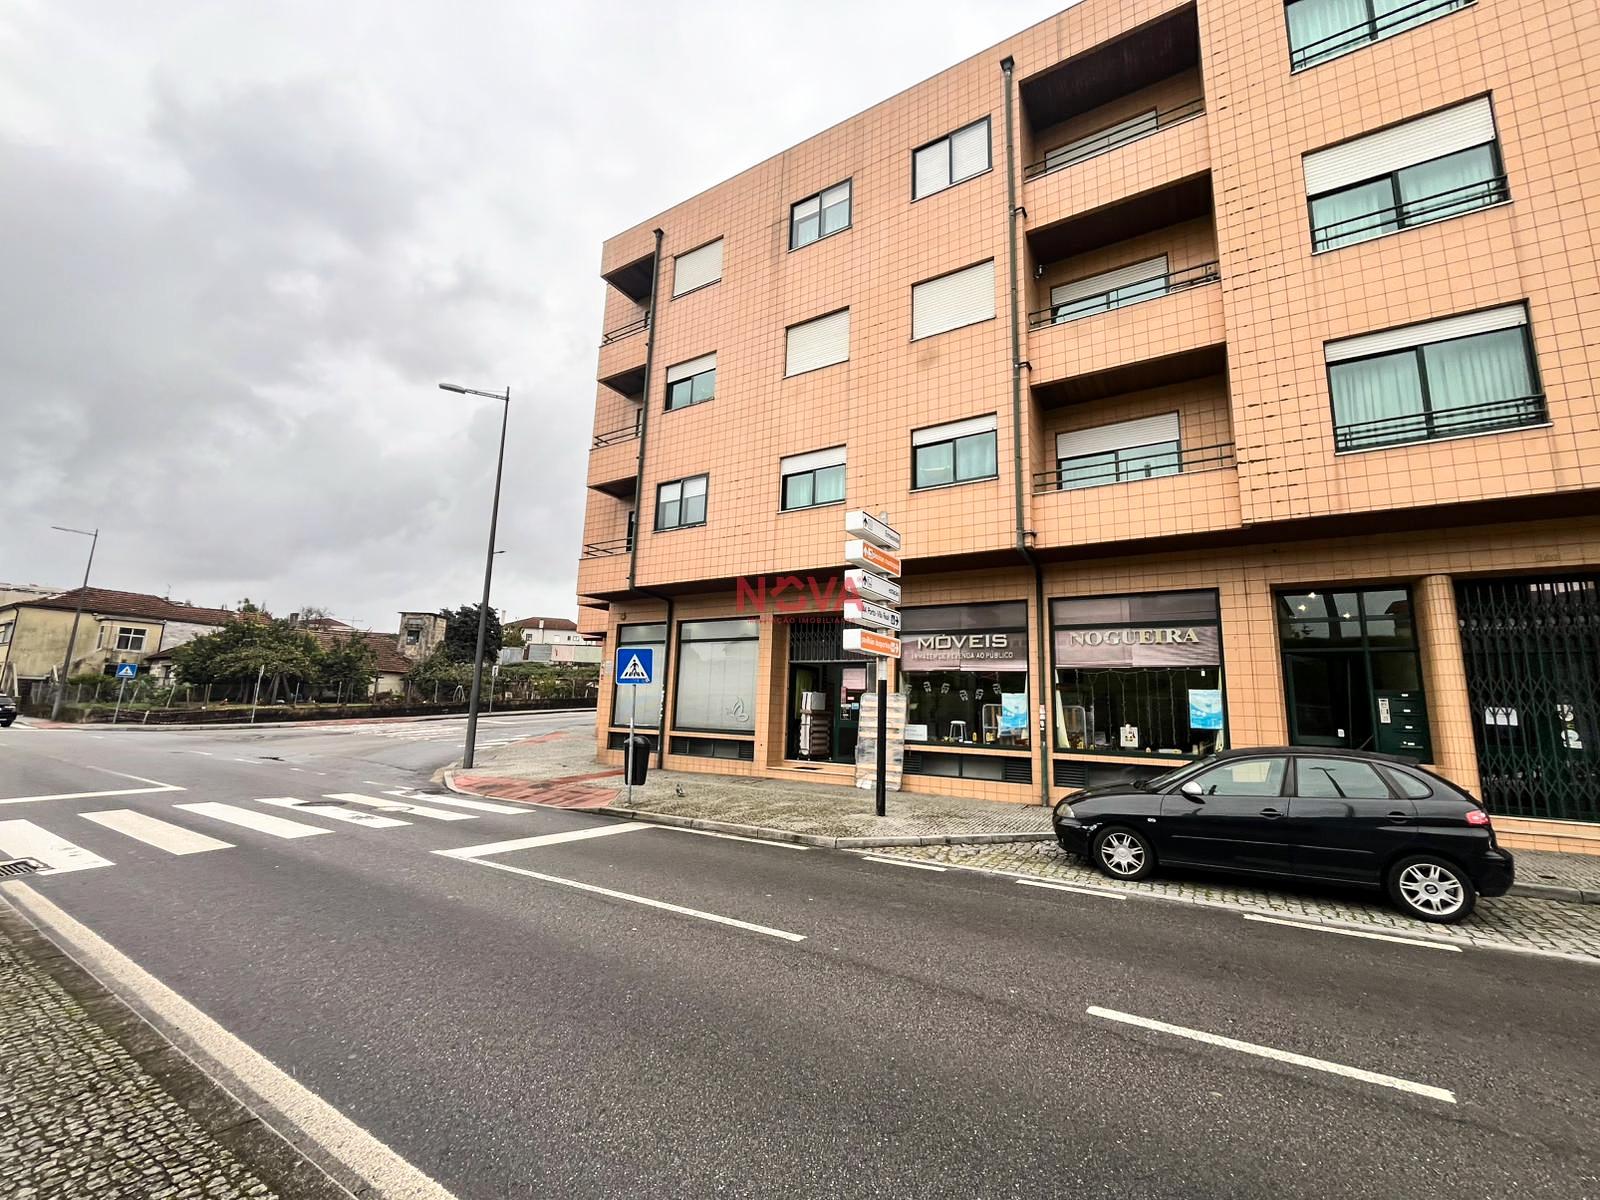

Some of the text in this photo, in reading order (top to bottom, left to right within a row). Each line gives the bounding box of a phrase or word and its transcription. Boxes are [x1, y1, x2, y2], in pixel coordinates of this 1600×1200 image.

[917, 634, 1008, 650] MÓVEIS
[1070, 628, 1200, 647] NOGUEIRA
[986, 651, 1013, 660] PÚBLICO
